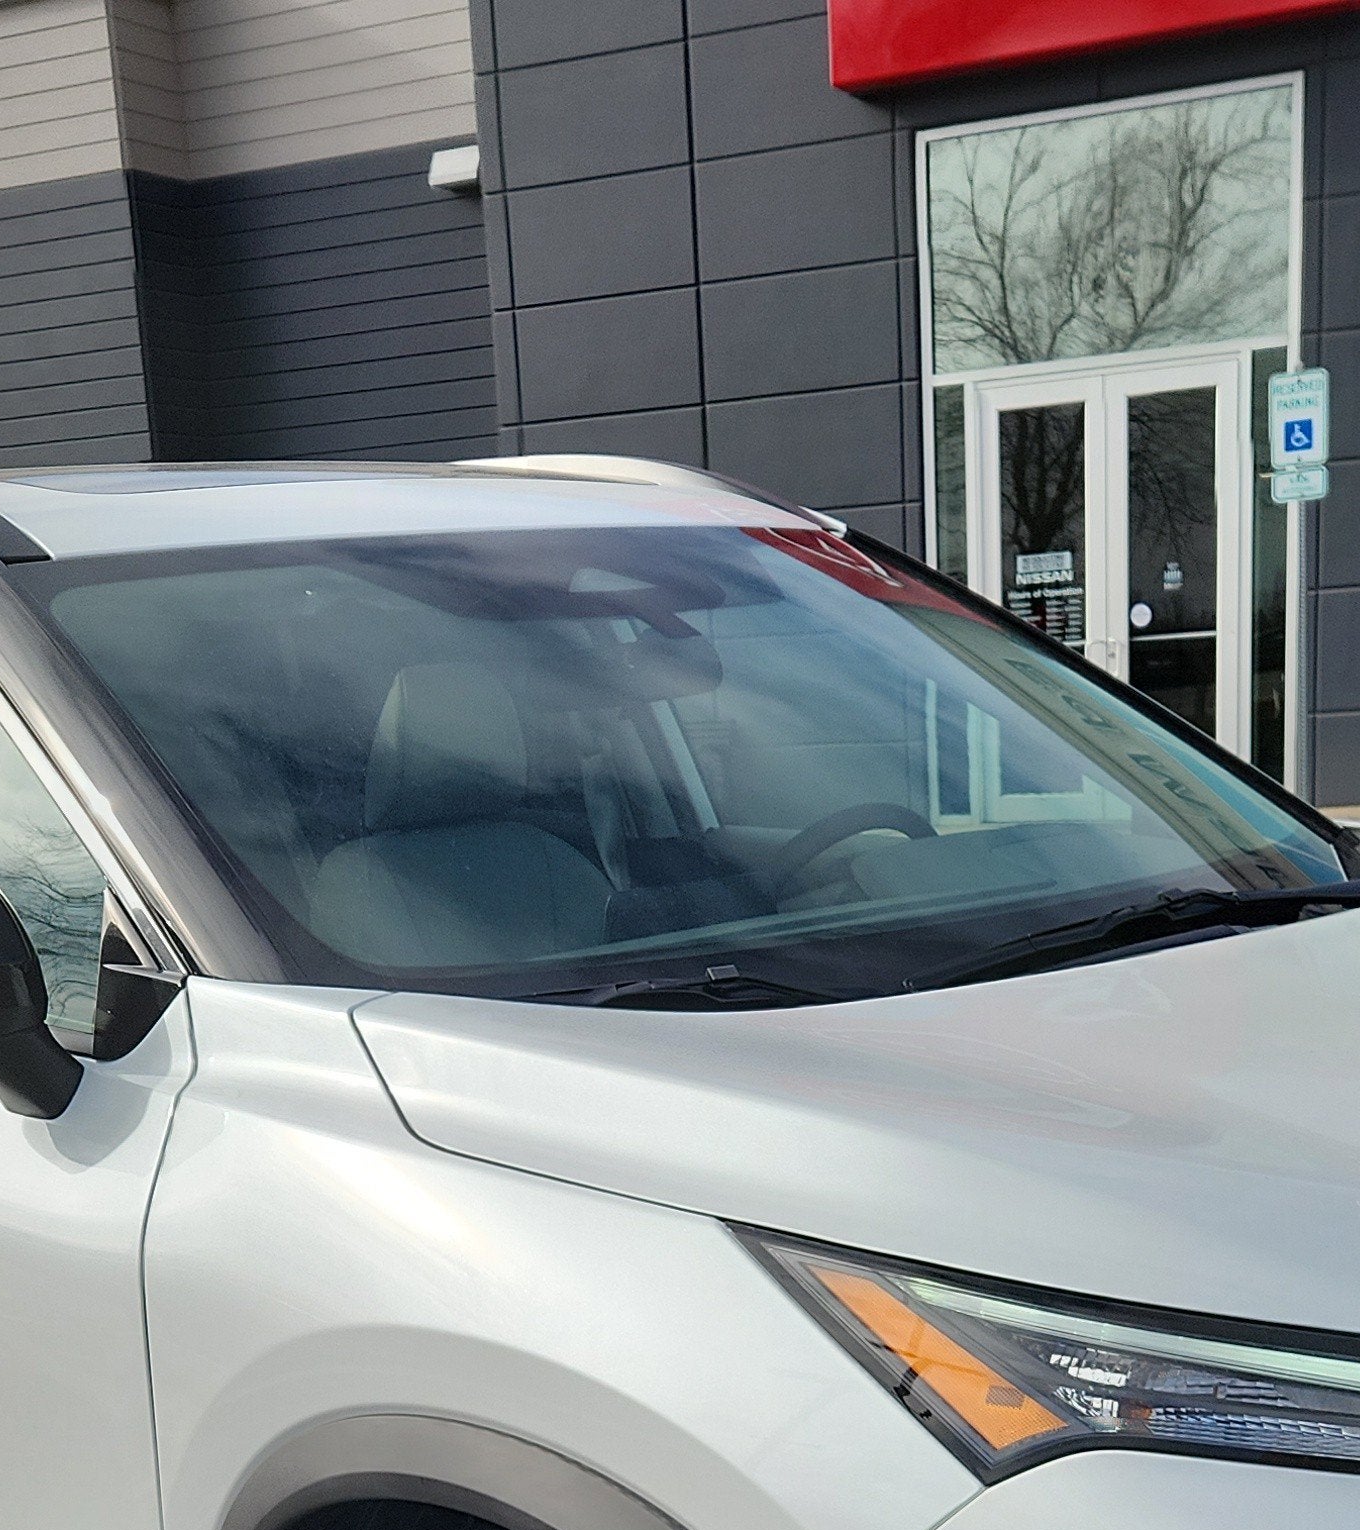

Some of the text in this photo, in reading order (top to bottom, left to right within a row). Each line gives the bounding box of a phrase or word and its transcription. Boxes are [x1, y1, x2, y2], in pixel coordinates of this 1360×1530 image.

[1272, 380, 1322, 394] RESERVED
[1276, 397, 1319, 410] PARKING
[1016, 570, 1074, 585] NISSAN
